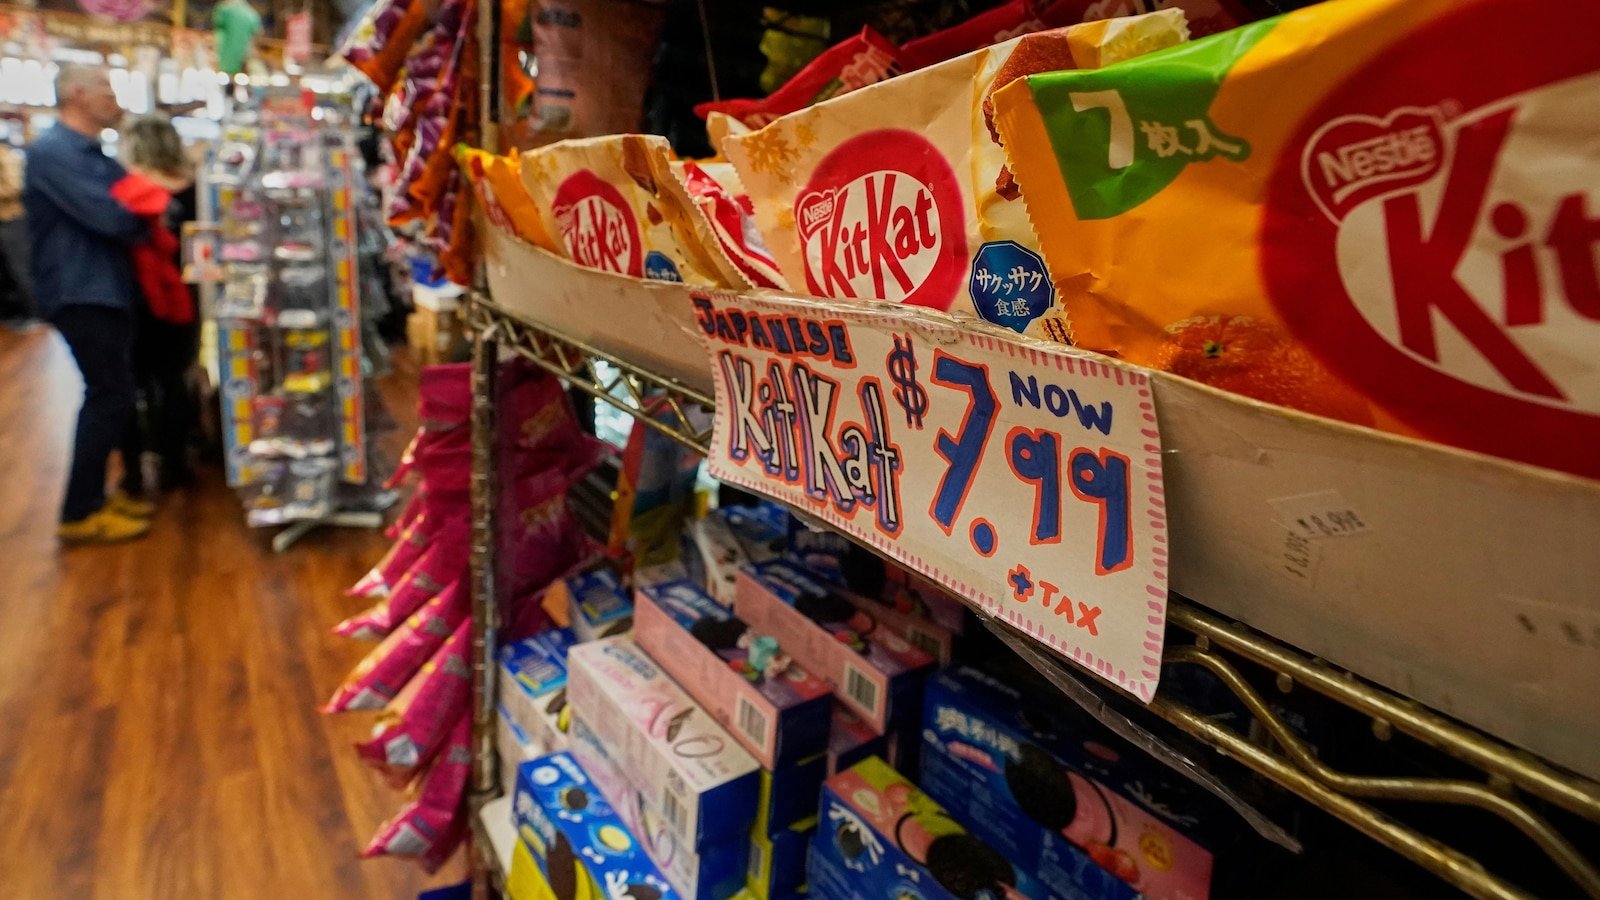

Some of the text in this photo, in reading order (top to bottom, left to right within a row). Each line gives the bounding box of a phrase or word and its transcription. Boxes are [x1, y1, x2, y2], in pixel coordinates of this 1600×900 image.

[819, 172, 937, 301] KitKat
[975, 265, 1043, 296] サクッサク
[994, 297, 1030, 317] 食感
[690, 294, 857, 369] JAPANESE
[1008, 370, 1113, 436] NOW
[718, 348, 904, 540] KitKat
